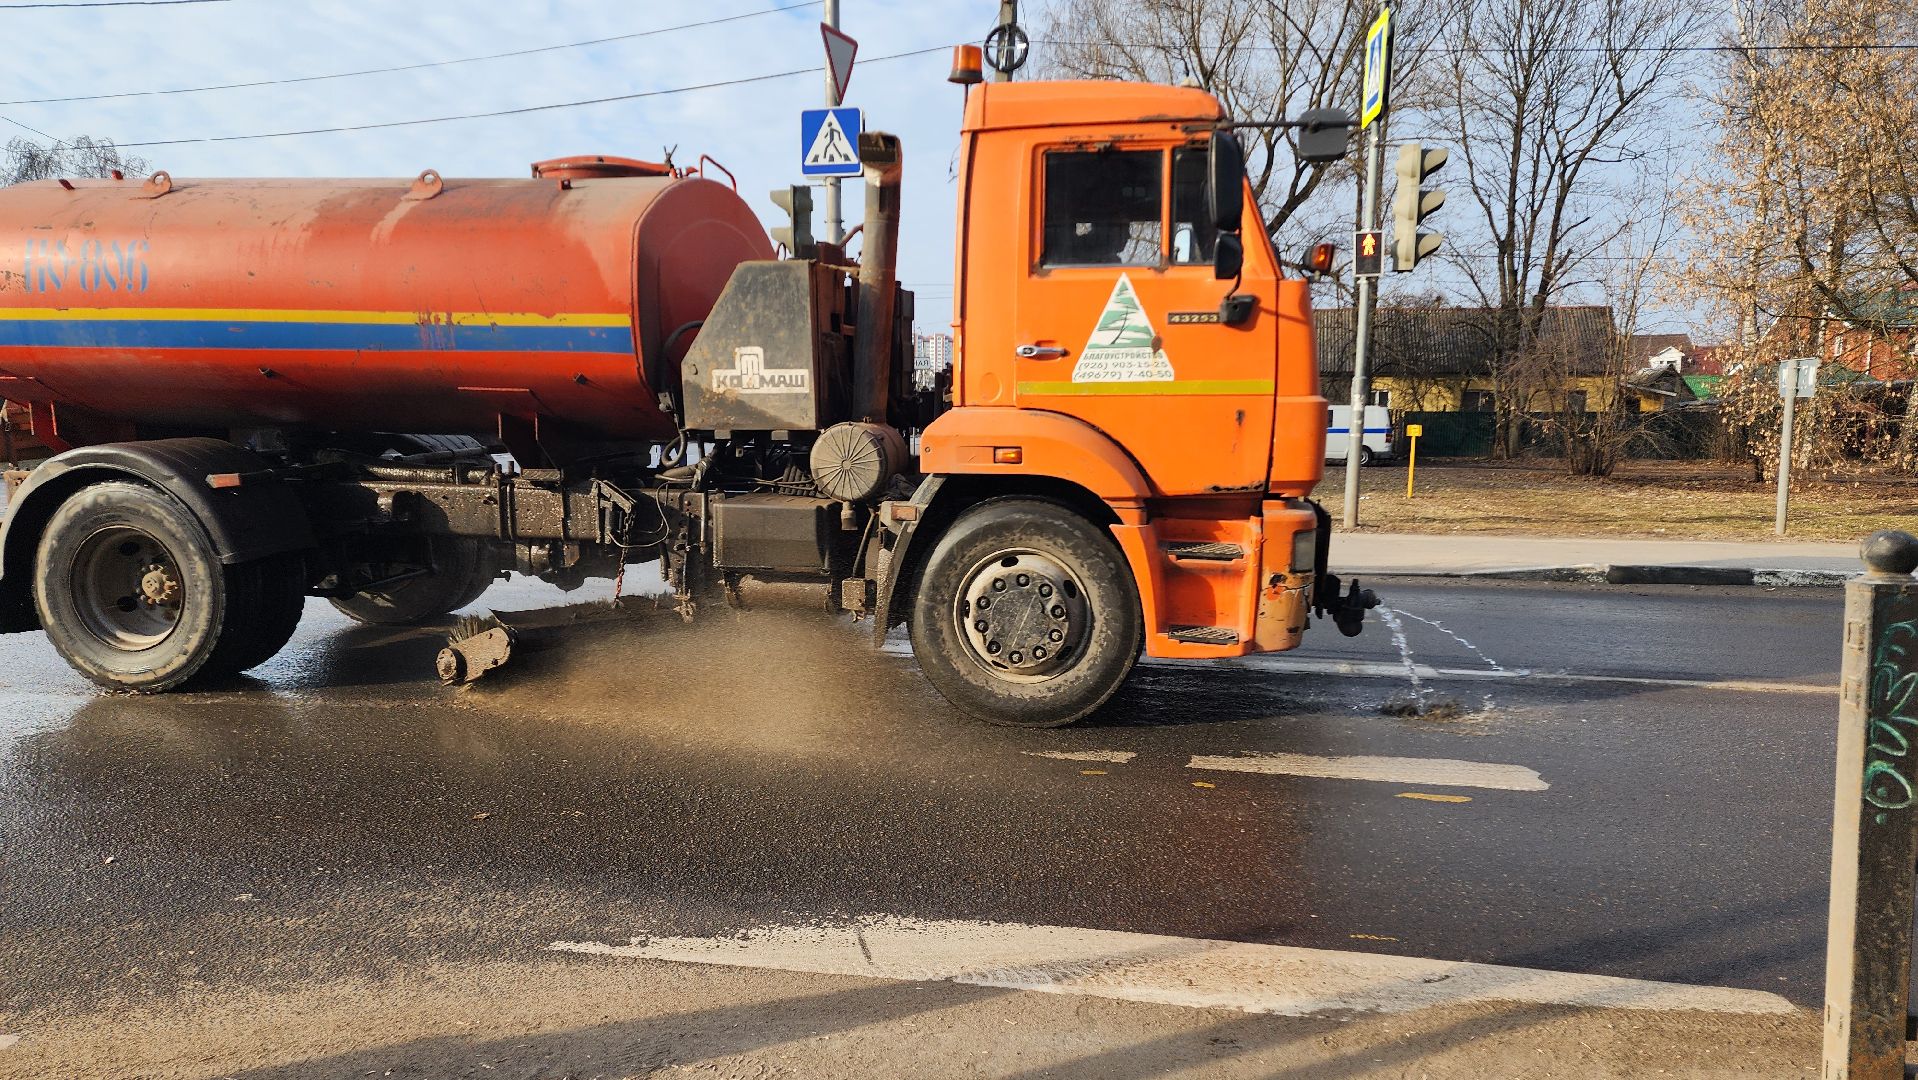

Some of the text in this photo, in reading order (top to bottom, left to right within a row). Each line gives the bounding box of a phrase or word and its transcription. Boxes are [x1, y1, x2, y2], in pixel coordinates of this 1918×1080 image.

[1170, 314, 1218, 323] 43253
[1078, 361, 1108, 370] (926)
[1073, 370, 1173, 381] (49679) 7-40-50
